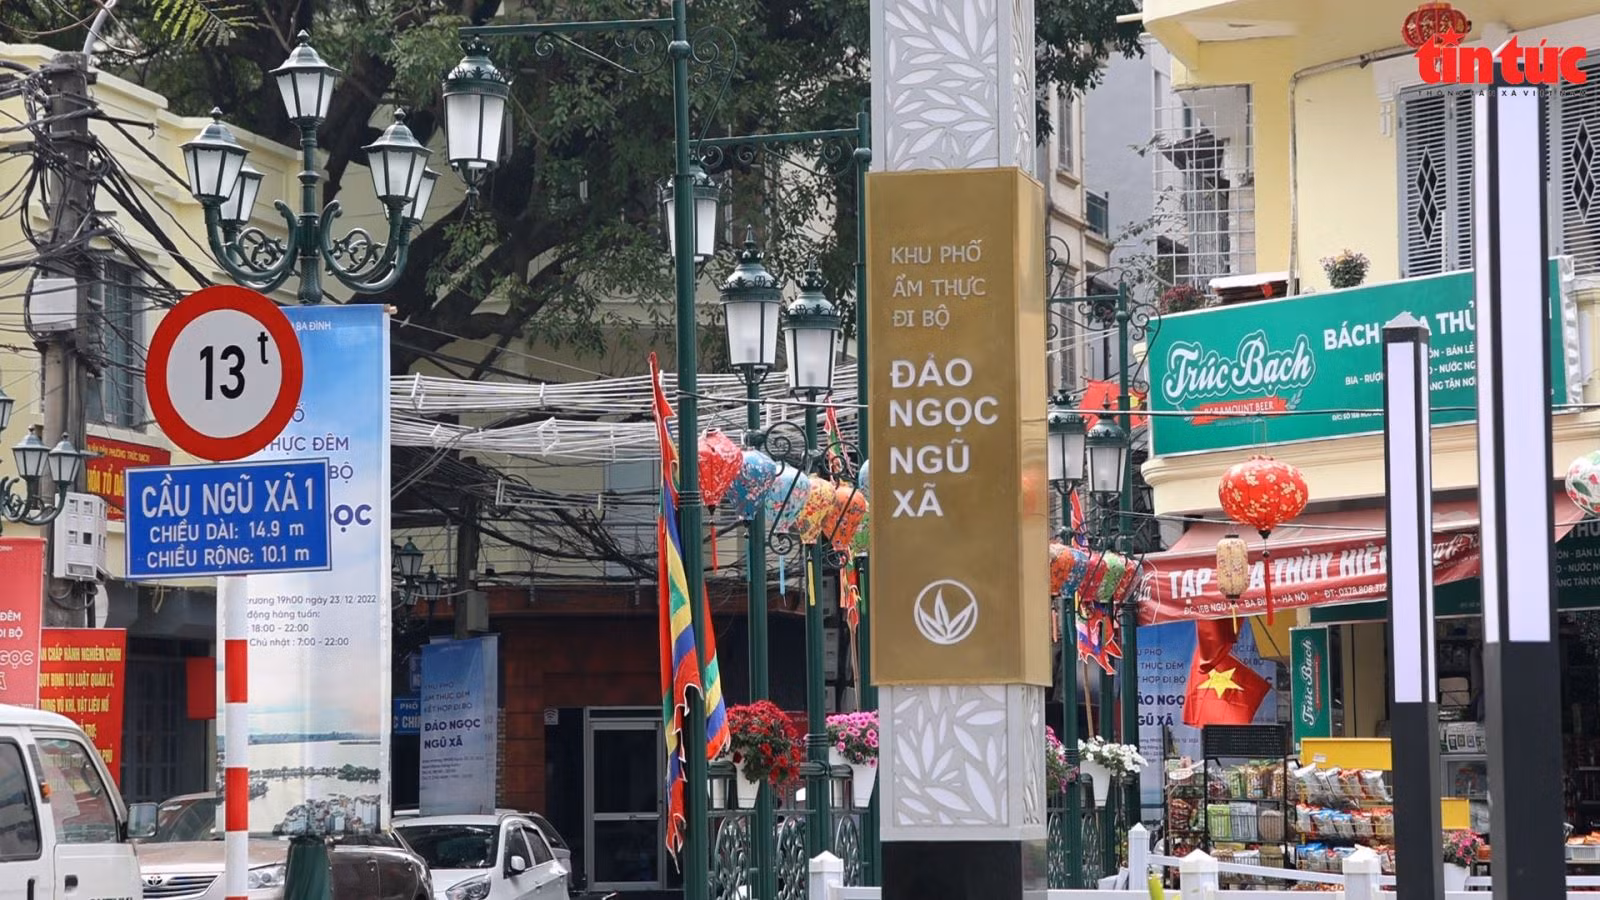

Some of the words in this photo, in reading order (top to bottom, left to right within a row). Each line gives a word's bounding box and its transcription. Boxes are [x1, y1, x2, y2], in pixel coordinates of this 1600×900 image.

[891, 246, 931, 264] KHU
[940, 239, 982, 263] PHỐ
[892, 273, 923, 297] ẨM
[931, 276, 986, 300] THỰC
[296, 322, 309, 331] BA
[309, 319, 332, 331] ĐÌNH
[892, 309, 915, 327] ĐI
[922, 303, 950, 330] BỘ
[1323, 320, 1380, 351] BÁCH
[1434, 300, 1476, 335] THỦ
[1446, 344, 1464, 356] BÁN
[199, 344, 246, 401] 13
[257, 331, 269, 365] t
[889, 352, 973, 388] ĐẢO
[1166, 348, 1228, 398] Trúc
[1231, 337, 1311, 390] Bạch
[1345, 376, 1359, 385] BIA
[1444, 377, 1461, 390] TẬN
[889, 396, 999, 433] NGỌC
[1255, 401, 1274, 412] BEER
[264, 436, 306, 456] HỰC
[312, 433, 349, 452] ĐÊM
[889, 438, 970, 474] NGŨ
[329, 461, 354, 484] BỘ
[141, 473, 191, 518] CẦU
[202, 473, 254, 516] NGŨ
[264, 471, 300, 513] XÃ
[304, 478, 314, 511] 1
[892, 482, 944, 518] XÃ
[330, 504, 372, 533] ỌC
[150, 518, 199, 544] CHIỀU
[206, 518, 239, 541] DÀI:
[249, 520, 281, 540] 14.9
[289, 522, 305, 537] m
[147, 543, 197, 568] CHIỀU
[203, 545, 254, 569] RỘNG:
[261, 545, 287, 563] 10.1
[294, 547, 310, 561] m
[1169, 567, 1212, 604] TẠP
[1274, 547, 1335, 587] THỦY
[277, 596, 303, 604] 19h00
[305, 596, 328, 606] ngày
[247, 610, 270, 620] động
[272, 609, 296, 620] hàng
[9, 626, 23, 640] BỘ
[251, 624, 275, 632] 18:00
[284, 623, 309, 632] 22:00
[249, 637, 268, 647] Chủ
[270, 637, 290, 647] nhật
[298, 638, 316, 646] 7:00
[324, 637, 349, 646] 22:00
[0, 649, 34, 669] GỌC
[1138, 692, 1155, 705] ẢO
[1157, 694, 1185, 709] NGỌ
[424, 719, 448, 732] ĐẢO
[449, 718, 481, 731] NGỌC
[1138, 713, 1154, 727] GŨ
[1157, 712, 1174, 727] XÃ
[424, 736, 447, 749] NGŨ
[449, 734, 463, 748] XÃ
